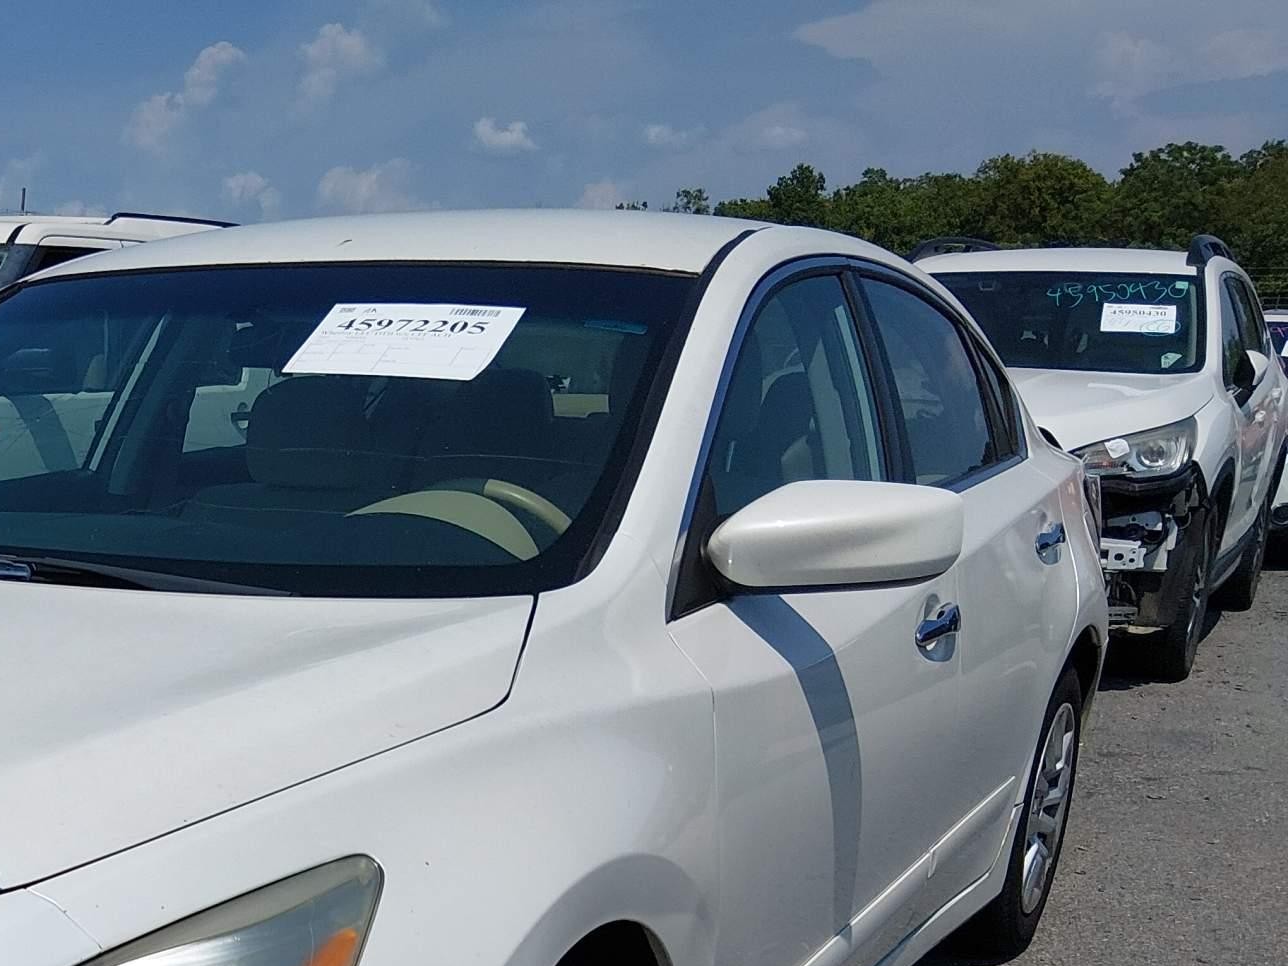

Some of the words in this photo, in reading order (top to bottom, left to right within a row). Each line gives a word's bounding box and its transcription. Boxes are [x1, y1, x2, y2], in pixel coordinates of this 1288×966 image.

[1046, 281, 1188, 308] 45950430
[1110, 309, 1167, 317] 45950430
[336, 318, 490, 335] 45972205
